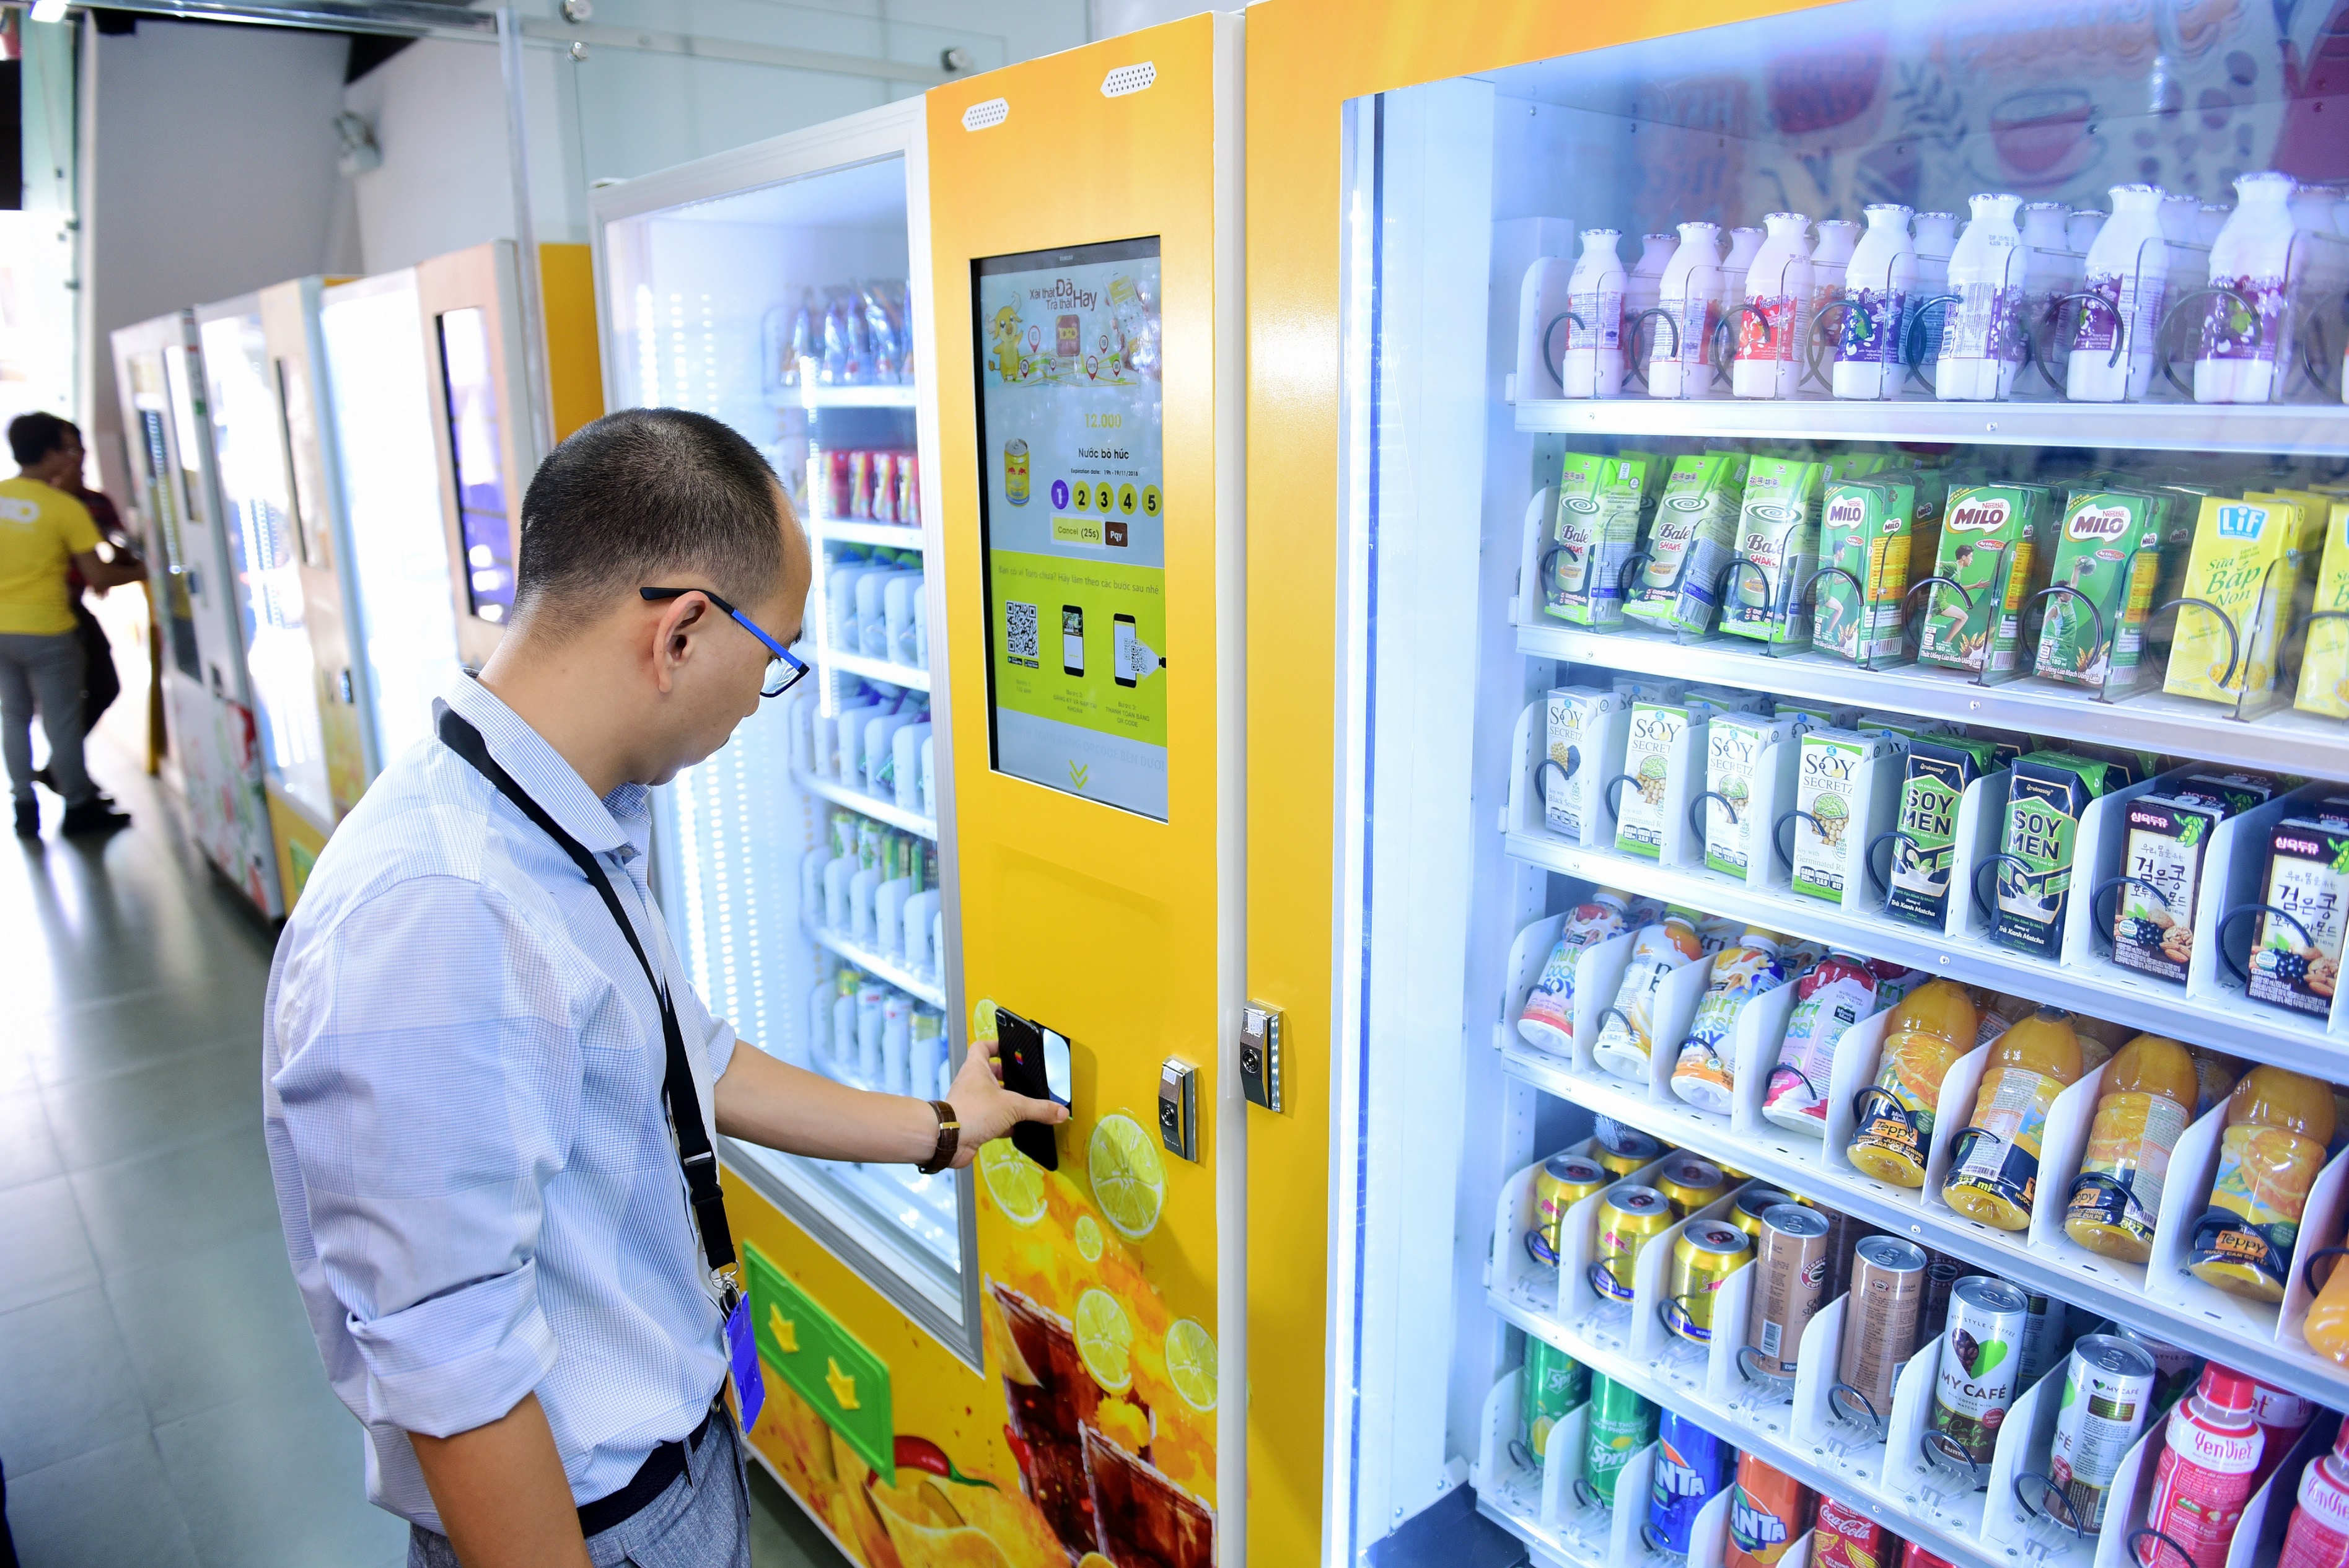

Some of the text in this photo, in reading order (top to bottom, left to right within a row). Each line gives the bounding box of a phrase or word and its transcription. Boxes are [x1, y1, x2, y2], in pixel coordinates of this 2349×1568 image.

[1073, 289, 1097, 312] Hay
[1759, 295, 1789, 309] Yoghut
[1864, 289, 1897, 304] Yoghut
[1085, 414, 1122, 427] 12.000
[1079, 447, 1129, 459] Nước bò húc
[1056, 488, 1156, 511] 1 2 3 4 5
[1830, 506, 1861, 522] MILO
[1954, 509, 2004, 525] MILO
[1884, 522, 1900, 531] MILO
[2073, 517, 2124, 533] MILO
[1058, 526, 1122, 542] Cancel (25s) Pay
[2142, 537, 2155, 545] MILO
[1659, 541, 1682, 551] SHAKE
[2206, 558, 2235, 571] Sữa
[1025, 569, 1037, 577] Toro
[1085, 577, 1099, 586] theo
[1101, 579, 1112, 588] các
[1113, 580, 1130, 590] bước
[1133, 584, 1143, 592] sau
[2206, 560, 2261, 595] Bắp
[2215, 590, 2250, 607] Non
[2045, 664, 2057, 674] Uống
[2065, 670, 2077, 678] Mạch
[2078, 672, 2089, 681] Uống
[1105, 706, 1121, 715] THANH
[1550, 706, 1583, 729] SOY
[1125, 719, 1138, 727] CODE
[1635, 719, 1682, 742] SOY
[1549, 726, 1583, 742] SECRETZ
[1711, 737, 1754, 763] SOY
[1710, 760, 1754, 776] SECRETZ
[1804, 753, 1856, 782] SOY
[1925, 765, 1944, 774] vinasoy
[1804, 776, 1853, 794] SECRETZ
[2032, 787, 2051, 796] vinasoy
[1548, 794, 1583, 811] Black Sesame
[1906, 787, 1954, 815] SOY
[1621, 813, 1655, 826] Germinated
[1901, 806, 1952, 836] MEN
[2012, 808, 2062, 838] SOY
[2130, 812, 2169, 828] 삼육두유
[1797, 847, 1807, 855] Soy
[2007, 831, 2060, 861] MEN
[2141, 843, 2185, 862] 우리 몸을 위한
[2275, 836, 2319, 856] 삼육두유
[1796, 855, 1834, 869] Germinated
[1802, 869, 1814, 877] GABA
[2135, 856, 2187, 891] 검은콩
[2285, 870, 2303, 883] 우리
[2305, 872, 2320, 887] 몸을
[1900, 901, 1914, 911] Xanh
[1915, 906, 1935, 917] Matcha
[2278, 884, 2339, 919] 검은콩
[2008, 927, 2022, 938] Xanh
[2022, 933, 2045, 945] Matcha
[1837, 1008, 1854, 1018] Minute
[1838, 1012, 1851, 1021] Maid
[1787, 1020, 1816, 1039] ost
[1877, 1121, 1915, 1140] Teppy
[1884, 1138, 1925, 1160] JUICE DRINK
[1905, 1150, 1922, 1163] PULPS
[2083, 1212, 2103, 1220] PULPS
[2086, 1208, 2106, 1216] DRINK
[2120, 1219, 2143, 1235] 327
[2221, 1232, 2265, 1253] Teppy
[1804, 1257, 1827, 1275] HIGHLA
[1964, 1318, 1987, 1328] STYLE
[1941, 1368, 2007, 1400] MY CAFÉ
[2106, 1385, 2140, 1395] MY CAFÉ
[1957, 1402, 1978, 1412] MATCHA
[1959, 1396, 1978, 1406] COFFEE
[1656, 1458, 1706, 1497] NTA
[1731, 1510, 1786, 1541] ANTA
[1820, 1504, 1875, 1540] Coca-Cola
[2171, 1512, 2198, 1528] Nutrition
